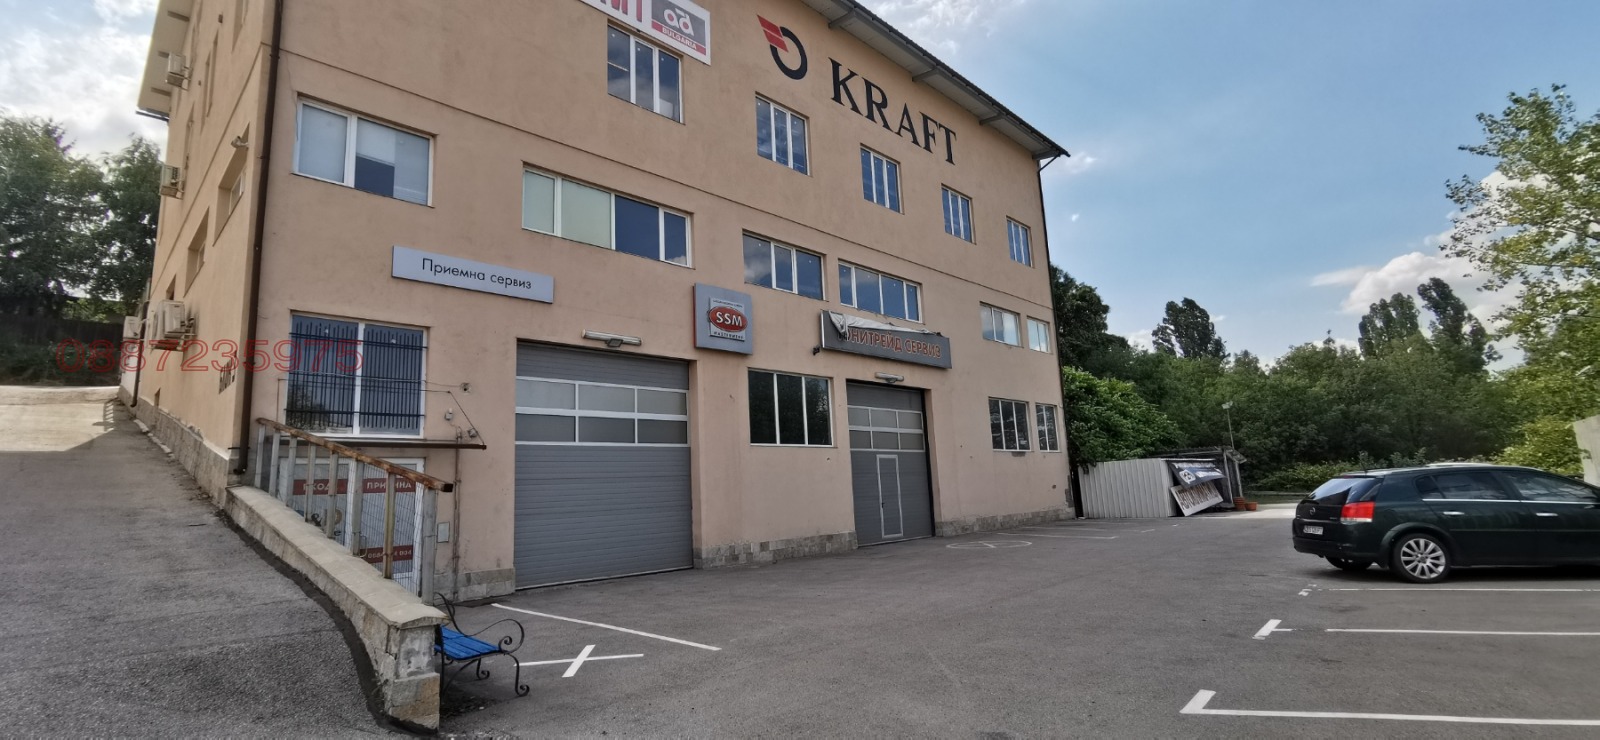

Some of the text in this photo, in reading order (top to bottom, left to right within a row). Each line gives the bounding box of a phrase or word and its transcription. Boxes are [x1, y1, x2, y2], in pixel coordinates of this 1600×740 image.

[662, 27, 697, 50] BULGARIA
[828, 57, 957, 165] KRAFT
[422, 257, 532, 289] Приемна сервиз
[716, 311, 743, 327] SSM
[904, 339, 942, 359] СЕРВИЗ
